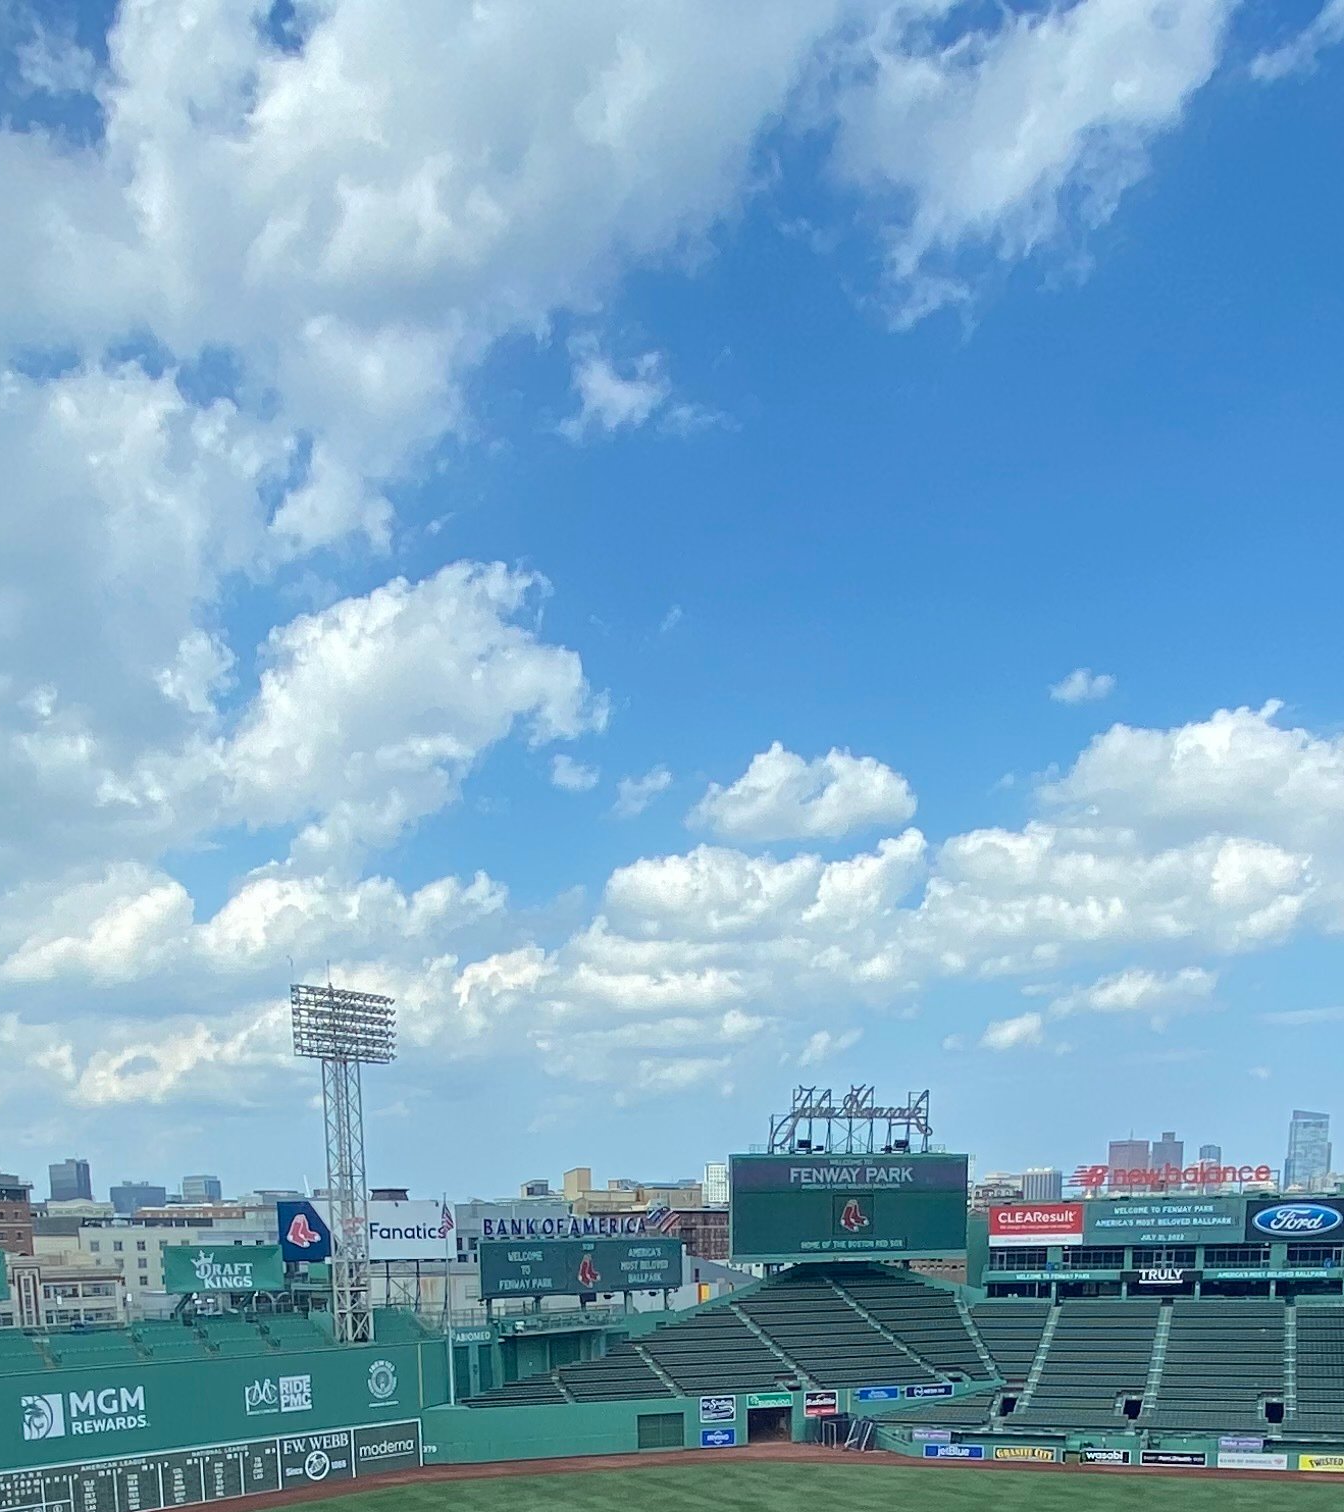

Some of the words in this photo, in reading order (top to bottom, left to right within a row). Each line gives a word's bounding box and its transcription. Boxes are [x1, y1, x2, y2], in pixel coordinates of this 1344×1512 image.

[773, 1085, 837, 1146] John
[837, 1084, 933, 1136] Hancock
[789, 1168, 861, 1184] FENWAY
[865, 1168, 913, 1182] PARK
[1113, 1167, 1162, 1185] new
[1165, 1162, 1271, 1183] balance
[1114, 1206, 1148, 1215] WELCOME
[1151, 1206, 1160, 1214] TO
[1162, 1205, 1192, 1213] FENWAY
[1193, 1205, 1214, 1213] PARK
[997, 1210, 1074, 1224] CLEAResult
[1095, 1219, 1133, 1227] AMERICA'S
[1136, 1218, 1154, 1226] MOST
[1157, 1218, 1191, 1226] BELOVED
[1193, 1217, 1231, 1225] BALLPARK
[1270, 1208, 1323, 1230] Ford
[369, 1222, 447, 1240] Fanatics
[483, 1218, 535, 1236] BANK
[542, 1218, 564, 1235] OF
[567, 1216, 647, 1235] AMERICA
[507, 1250, 544, 1262] WELCOME
[628, 1247, 662, 1258] AMERICA'S
[196, 1260, 254, 1280] DRAFT
[520, 1265, 531, 1276] TO
[620, 1261, 638, 1271] MOST
[639, 1259, 669, 1270] BELOVED
[627, 1273, 662, 1283] BALLPARK
[1139, 1269, 1184, 1281] TRULY
[204, 1275, 253, 1289] KINGS
[498, 1279, 530, 1290] FENWAY
[532, 1278, 553, 1289] PARK
[455, 1331, 491, 1342] ABIOMED
[280, 1381, 311, 1394] RIDE
[69, 1385, 145, 1416] MGM
[281, 1393, 311, 1407] PMC
[71, 1414, 146, 1435] REWARDS
[310, 1433, 349, 1450] WEBB
[359, 1439, 415, 1458] moderna
[938, 1446, 970, 1457] jetBlue
[996, 1448, 1033, 1458] GRANITE
[1034, 1447, 1054, 1459] CITY
[1085, 1449, 1123, 1460] wasabi
[80, 1462, 118, 1472] AMERICAN
[1309, 1457, 1343, 1469] TWISTED
[13, 1471, 42, 1480] PARK
